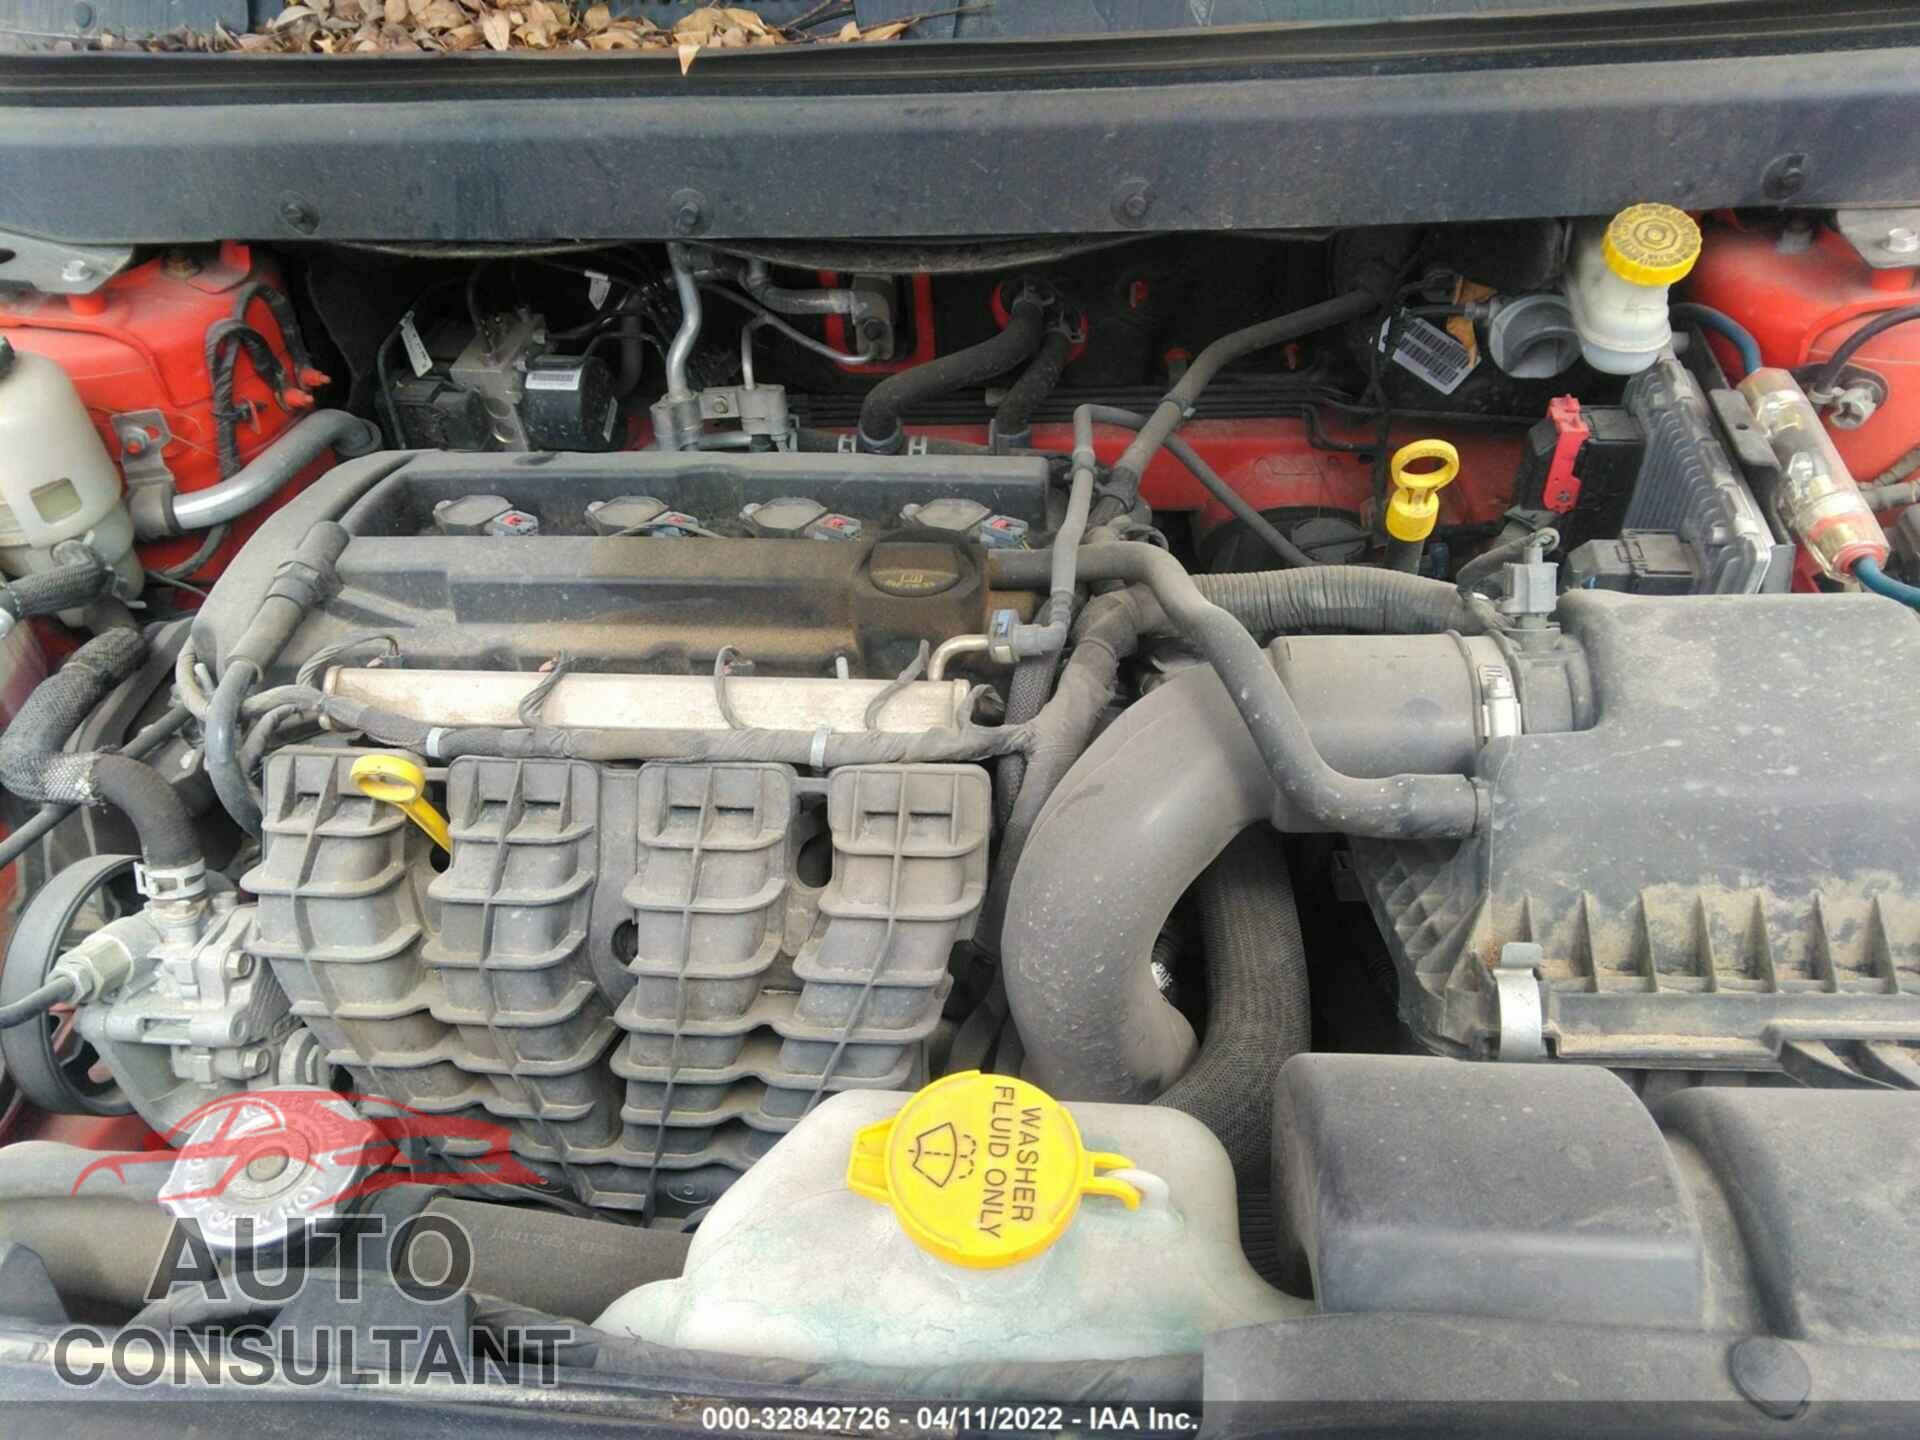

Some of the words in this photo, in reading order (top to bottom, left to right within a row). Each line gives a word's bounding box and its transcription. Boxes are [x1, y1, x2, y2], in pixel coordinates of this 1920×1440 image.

[987, 1086, 1015, 1158] FLUID
[1011, 1107, 1042, 1222] WASHER
[979, 1168, 1008, 1239] ONLY
